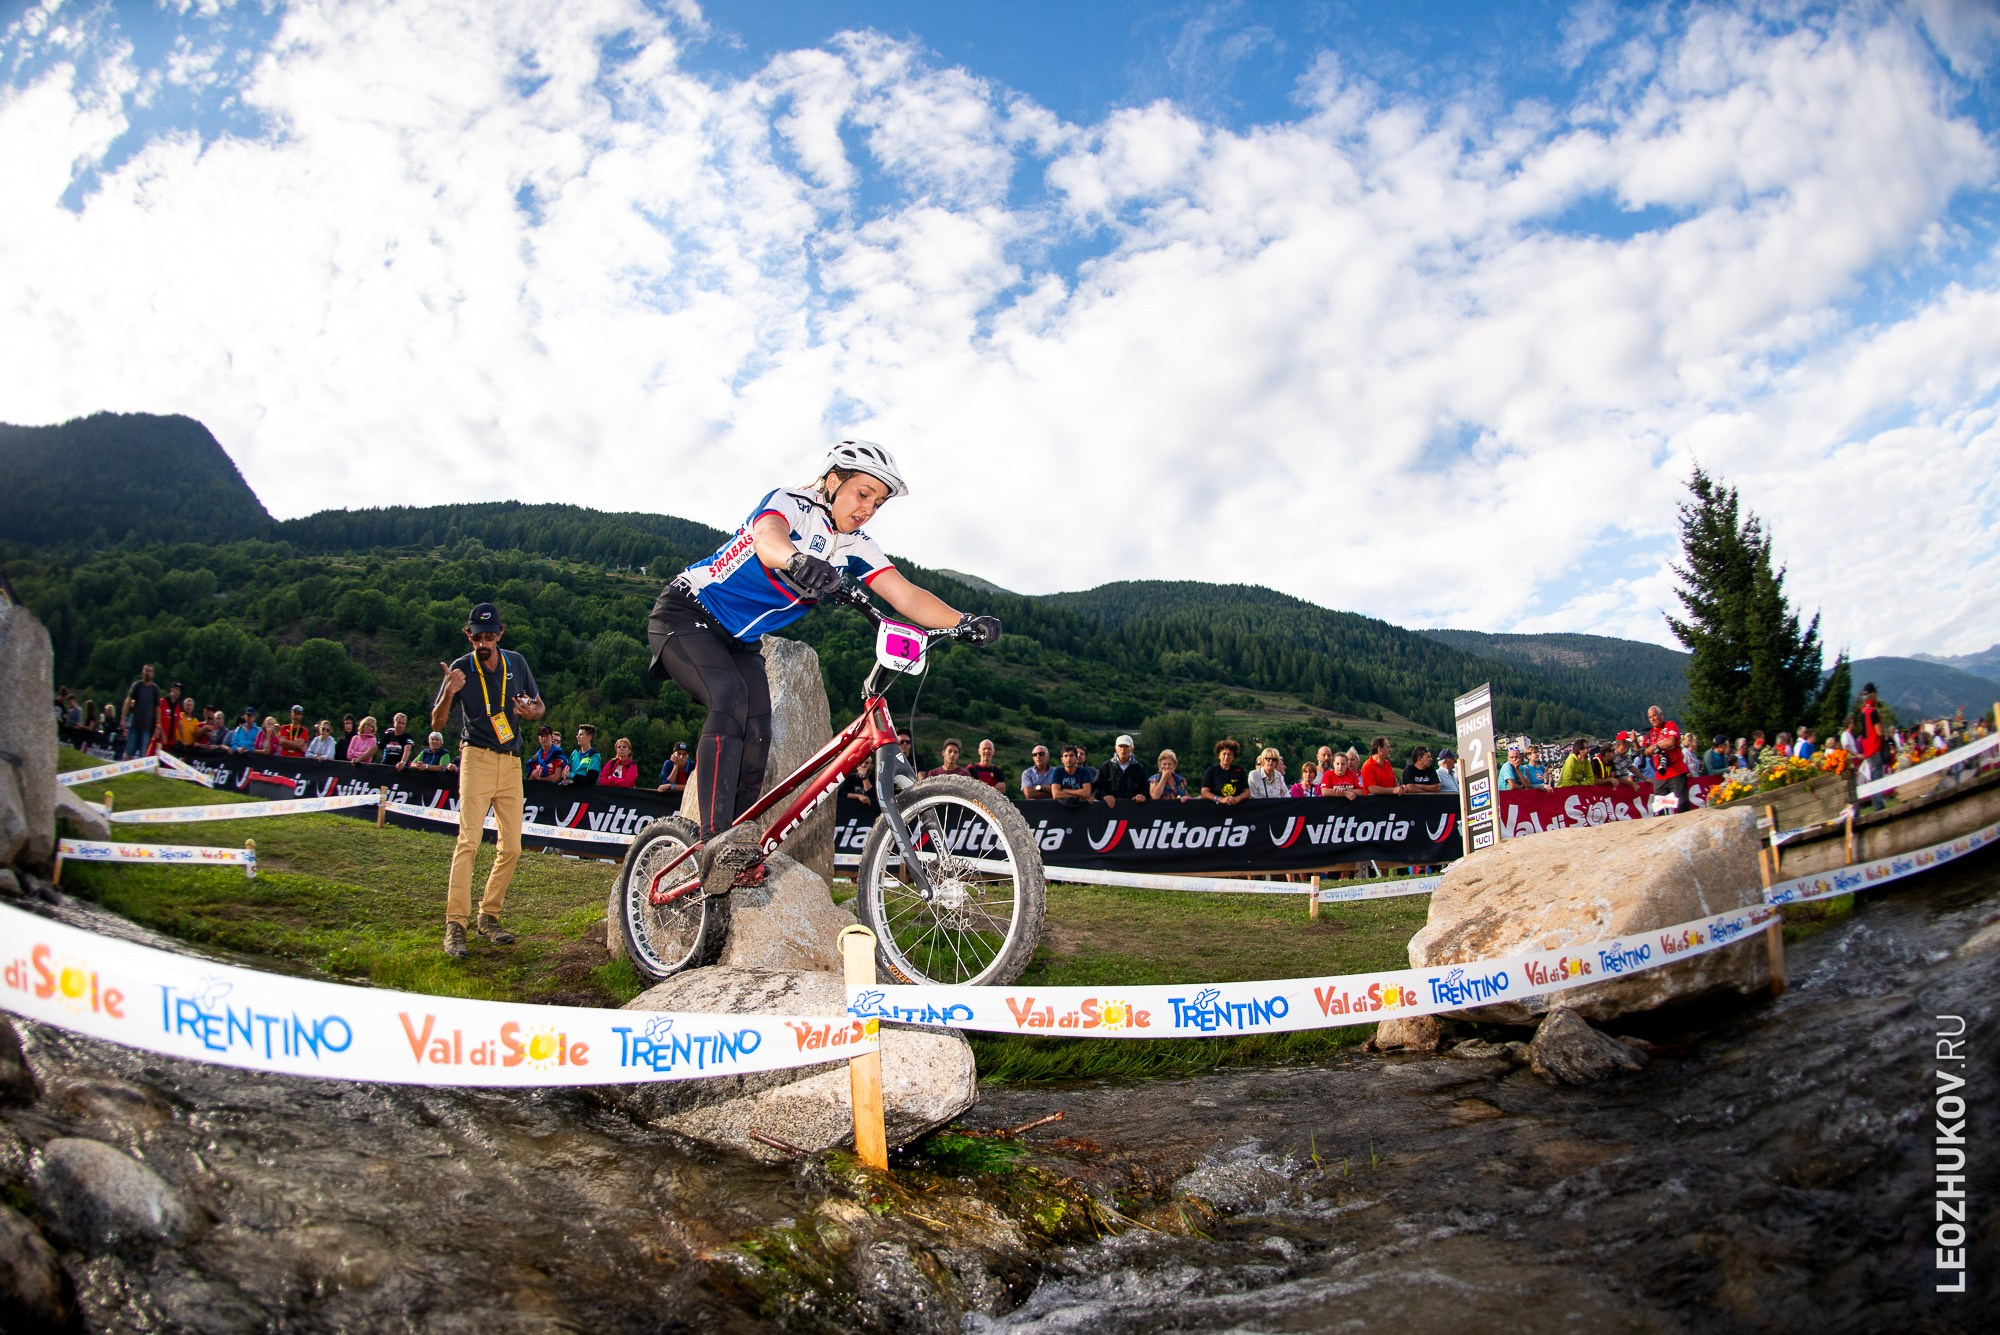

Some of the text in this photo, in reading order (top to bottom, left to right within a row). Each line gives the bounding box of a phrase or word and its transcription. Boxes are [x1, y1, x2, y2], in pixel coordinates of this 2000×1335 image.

[709, 534, 754, 578] STRABAG
[900, 638, 910, 658] 3
[1457, 712, 1491, 739] FINISH
[1469, 738, 1485, 771] 2
[1475, 780, 1487, 792] UCI
[588, 804, 654, 834] vitto
[1475, 811, 1488, 822] UCI
[1564, 794, 1631, 828] Sole
[1478, 833, 1491, 844] UCI
[1005, 997, 1054, 1029] Val
[1059, 1010, 1079, 1029] di
[1080, 997, 1152, 1030] Sole
[1168, 995, 1290, 1032] TRENTINO
[1314, 986, 1350, 1018] Val
[1352, 995, 1368, 1013] di
[1367, 982, 1417, 1012] Sole
[1428, 971, 1510, 1006] TRENTINO
[1524, 960, 1549, 988] Val
[1550, 968, 1560, 983] di
[1560, 956, 1592, 979] Sole
[1598, 943, 1651, 974] TRENTINO
[1660, 933, 1677, 955] Val
[1682, 929, 1705, 950] Sole
[1708, 917, 1745, 943] TRENTINO
[4, 943, 879, 1073] di Sole TRENTINO Val di Sole TRENTINO Val di So
